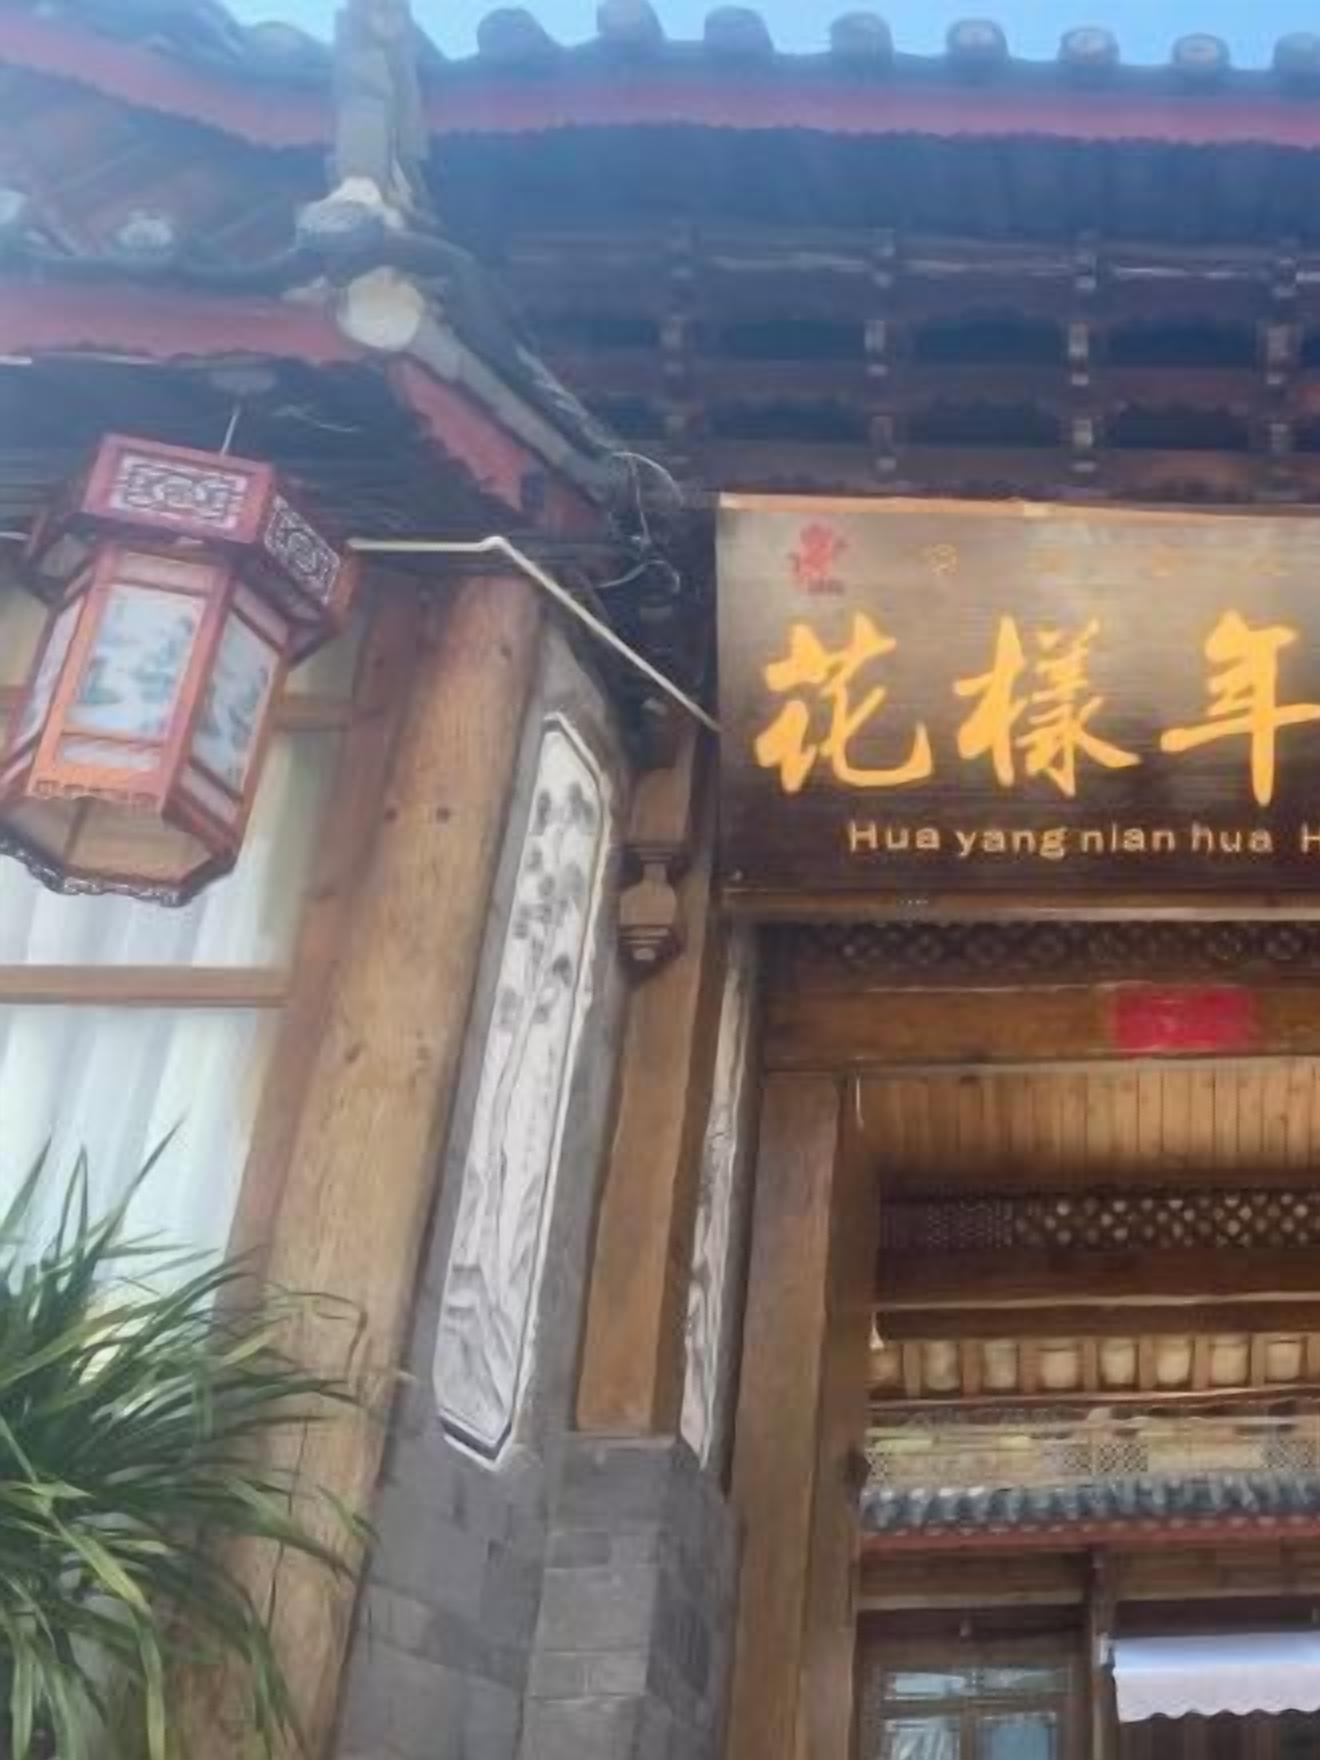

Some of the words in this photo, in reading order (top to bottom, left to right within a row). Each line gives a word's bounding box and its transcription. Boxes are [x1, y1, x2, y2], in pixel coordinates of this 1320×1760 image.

[848, 820, 941, 852] Hua
[955, 826, 1068, 860] yang
[1079, 822, 1177, 853] nian
[1190, 822, 1273, 853] hua
